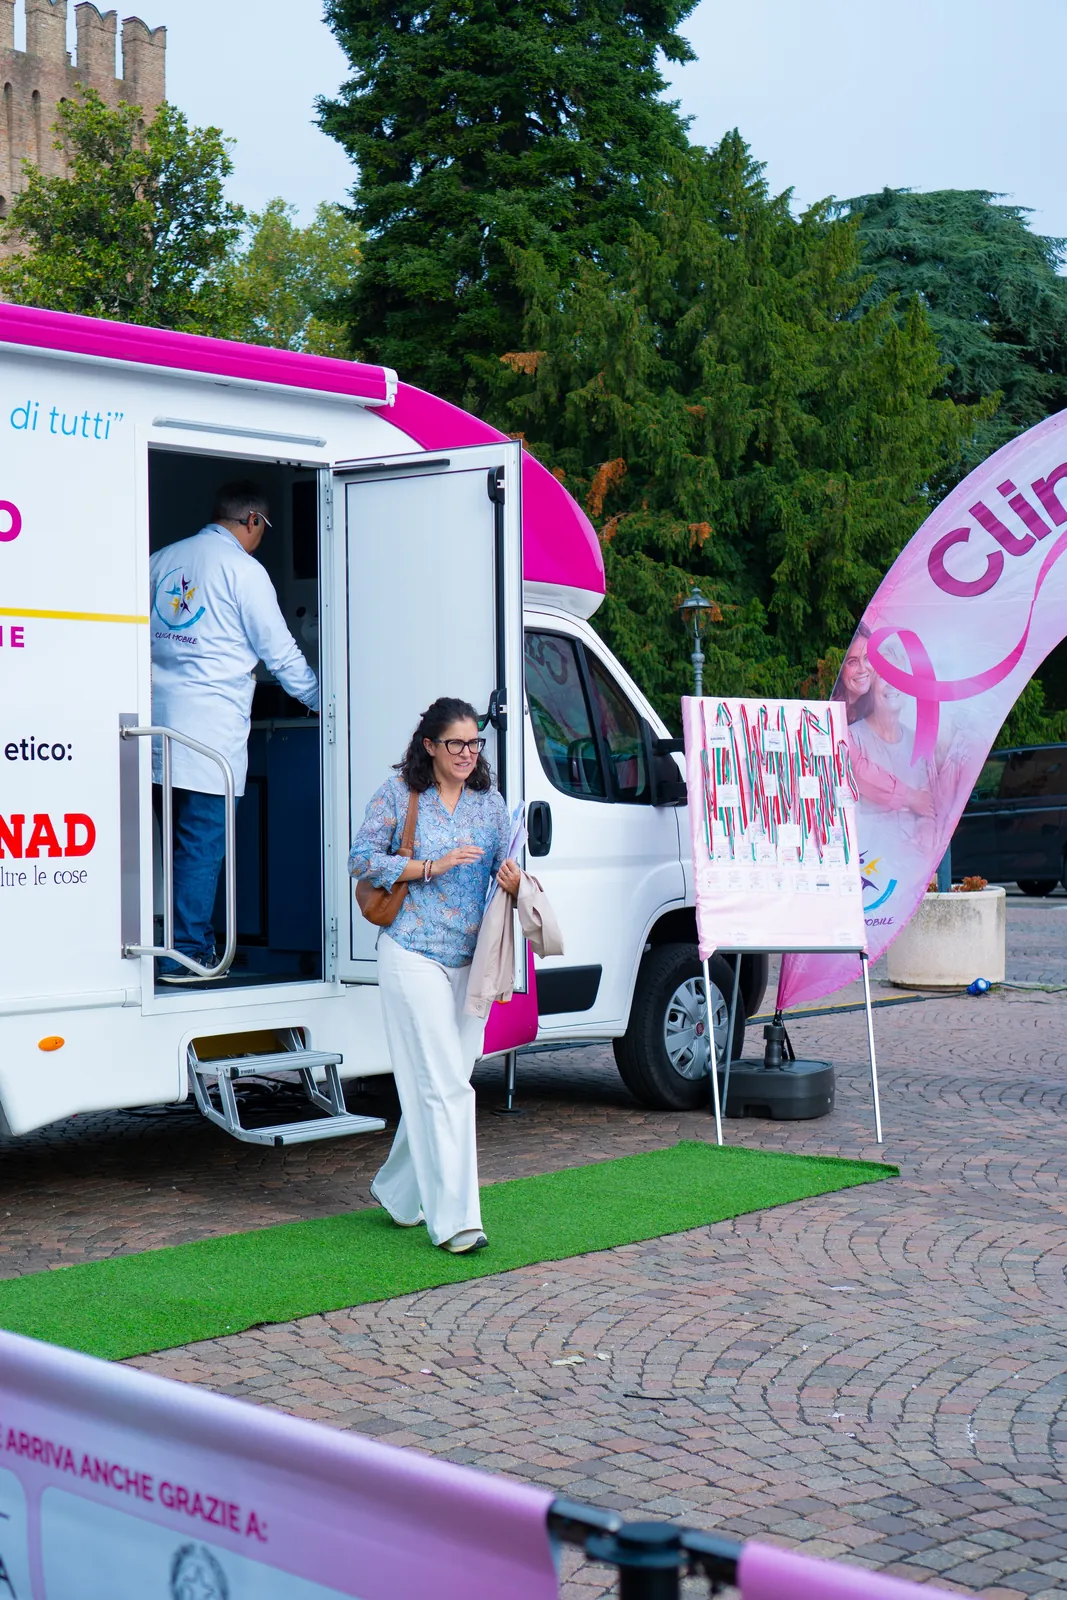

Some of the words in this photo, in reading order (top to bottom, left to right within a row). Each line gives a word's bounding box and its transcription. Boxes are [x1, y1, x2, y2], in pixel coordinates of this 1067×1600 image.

[10, 400, 40, 430] di
[172, 634, 197, 644] MOBILE
[4, 735, 73, 761] etico:
[0, 813, 97, 859] NAD
[33, 864, 47, 886] le
[53, 868, 88, 885] cose
[6, 1428, 77, 1476] ARRIVA
[80, 1453, 154, 1502] ANCHE
[158, 1481, 241, 1534] GRAZIE
[245, 1510, 269, 1543] A:
